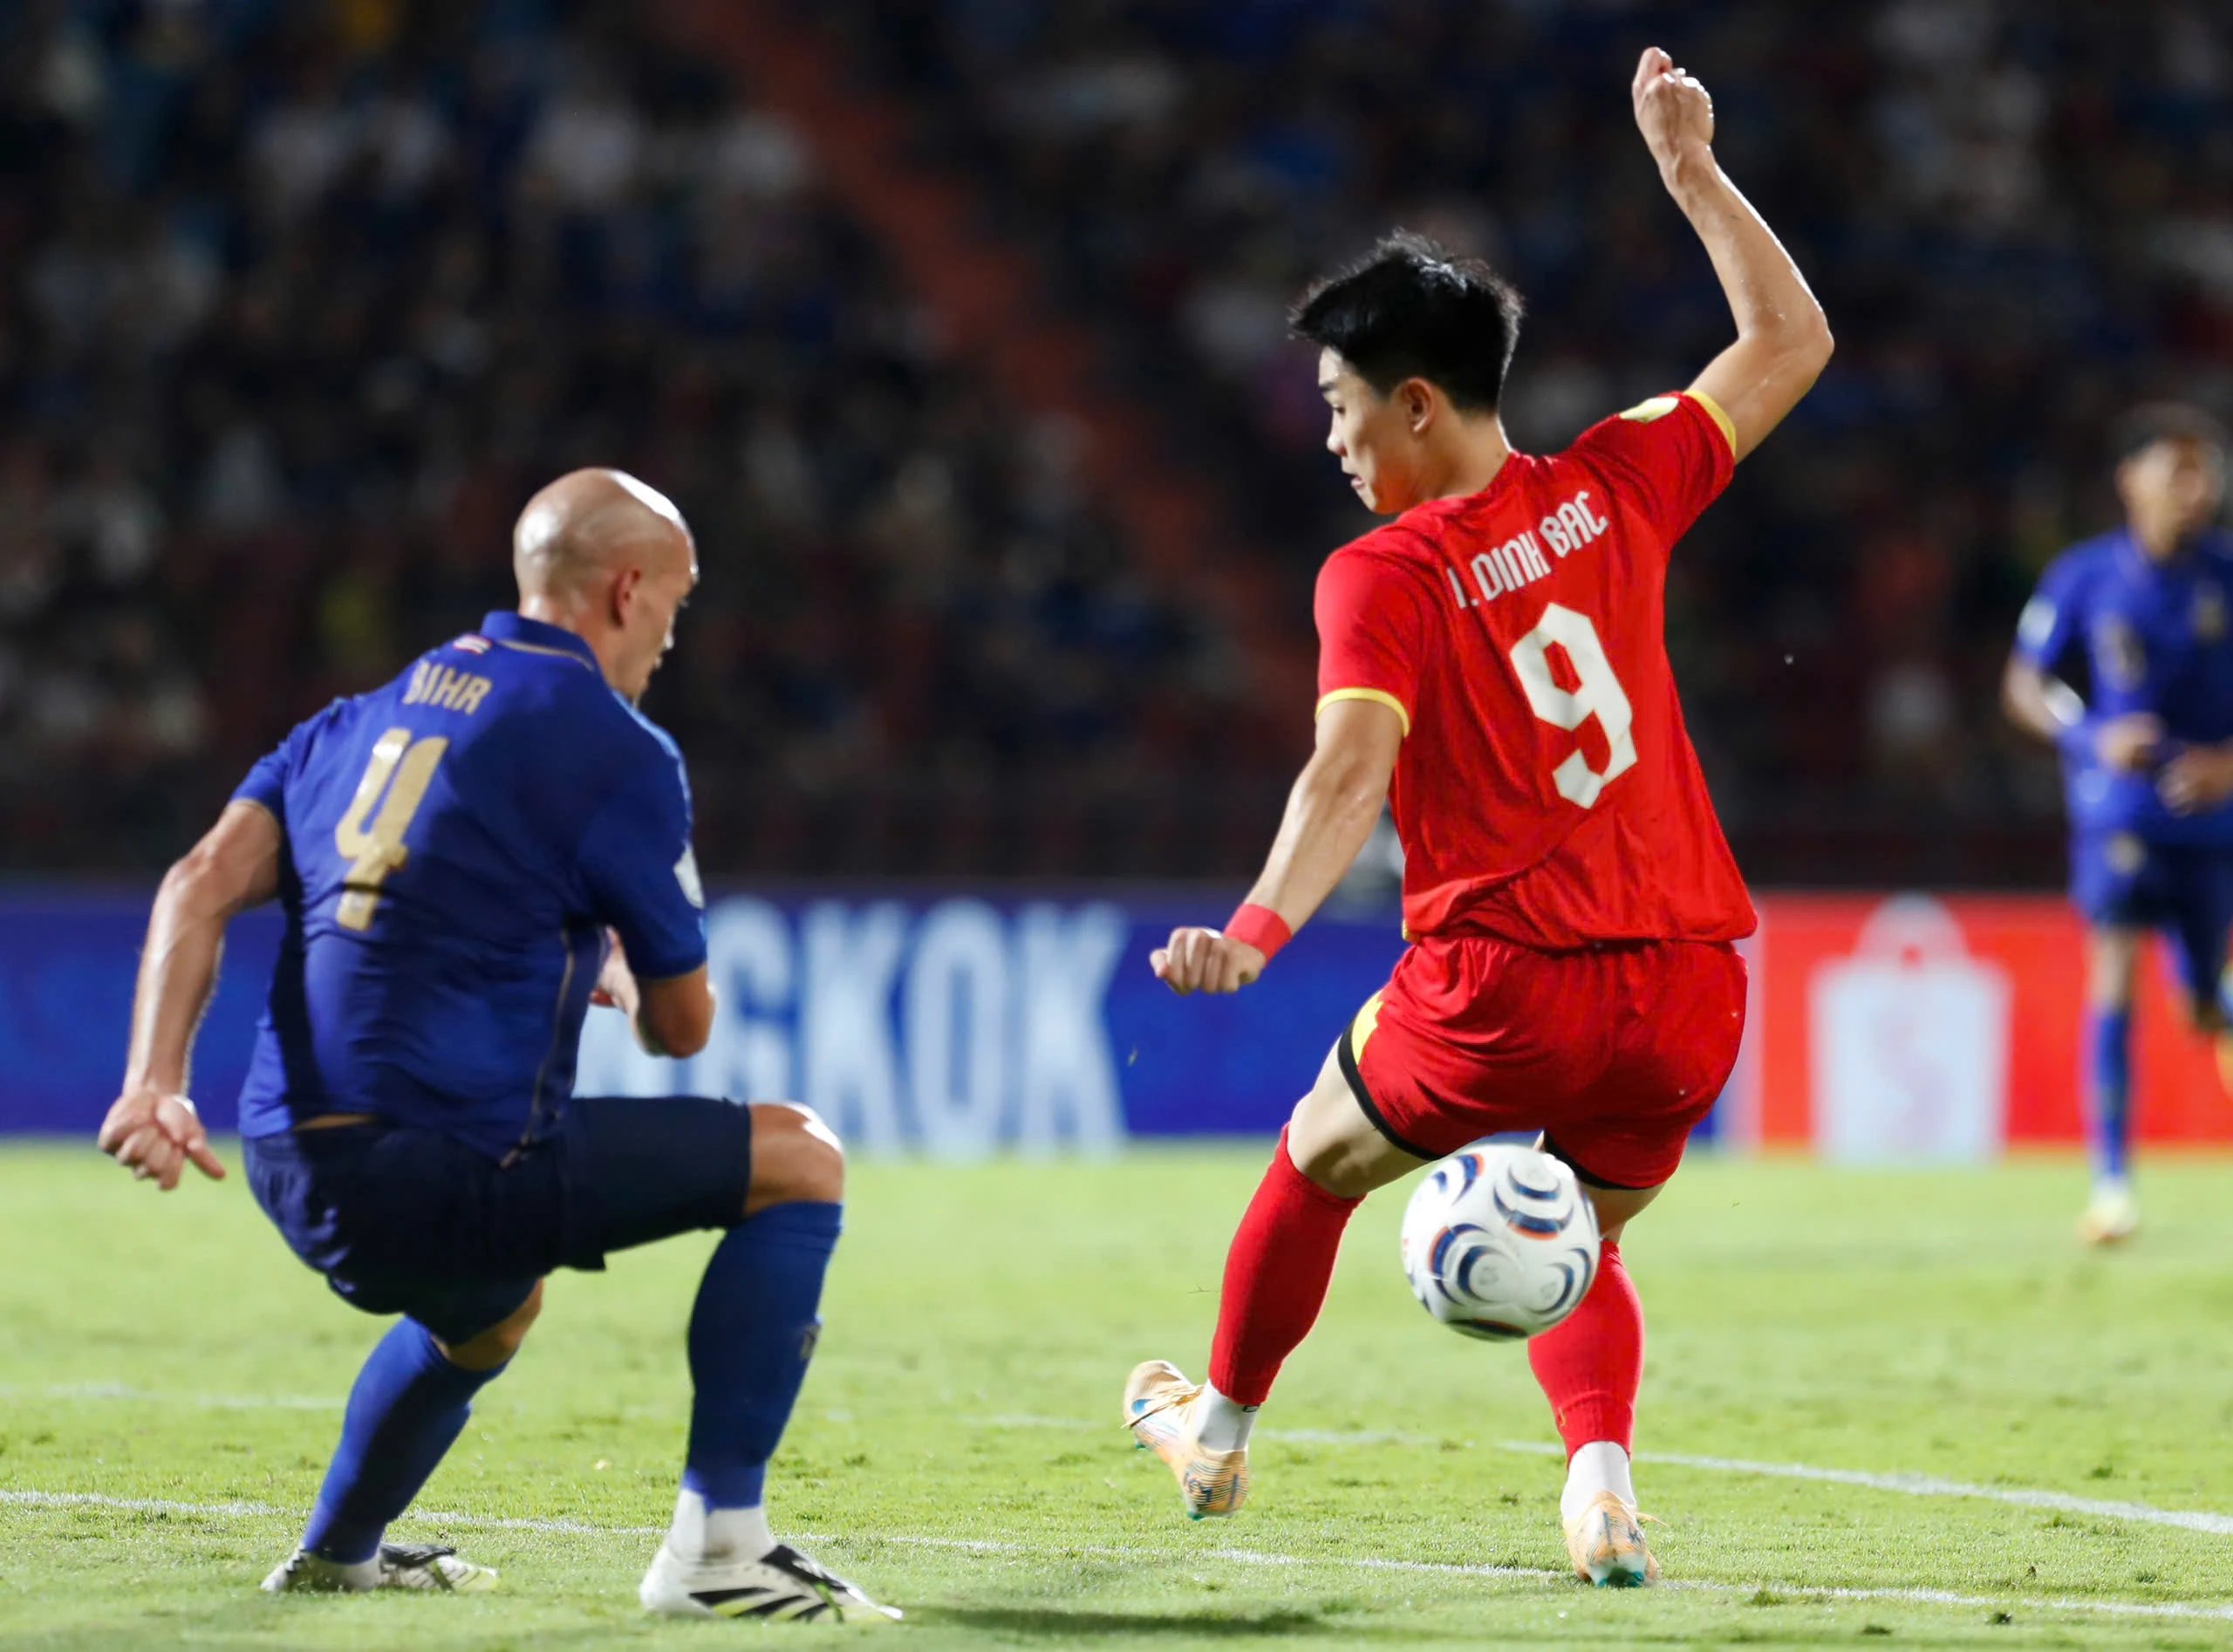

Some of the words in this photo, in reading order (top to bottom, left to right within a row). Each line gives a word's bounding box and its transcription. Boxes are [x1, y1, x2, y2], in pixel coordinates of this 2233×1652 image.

[1539, 490, 1608, 558] BAC
[1509, 602, 1637, 809] 9
[335, 727, 450, 932] 4
